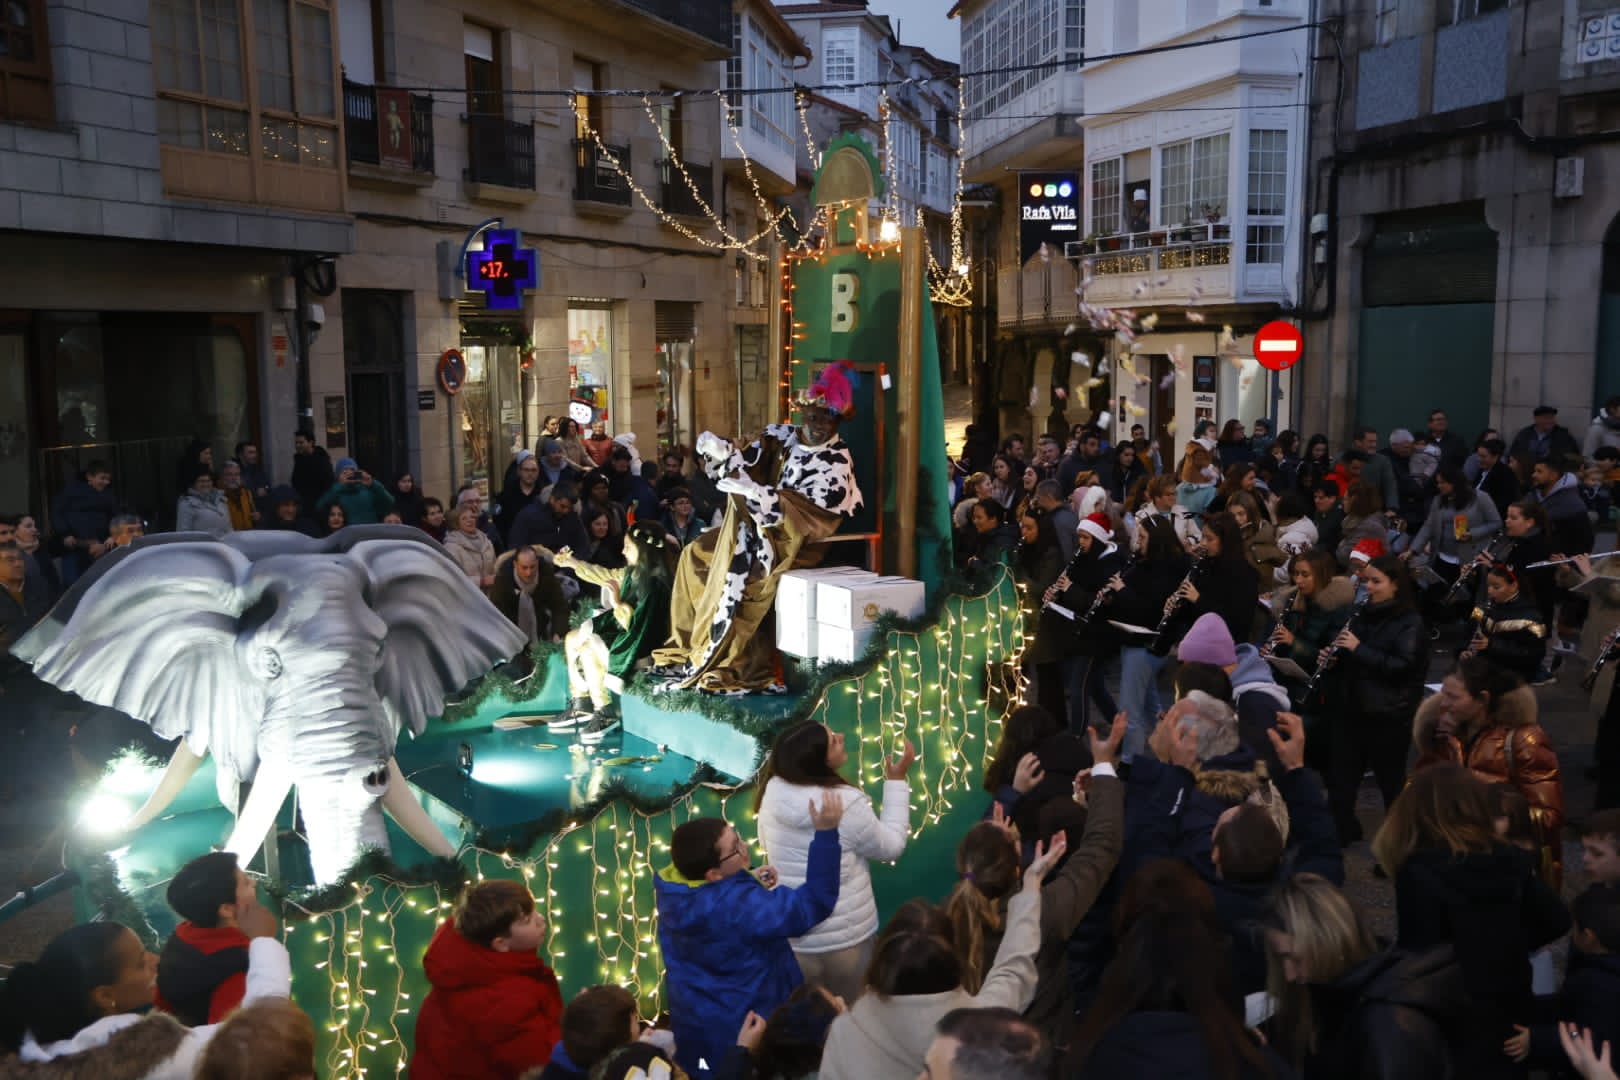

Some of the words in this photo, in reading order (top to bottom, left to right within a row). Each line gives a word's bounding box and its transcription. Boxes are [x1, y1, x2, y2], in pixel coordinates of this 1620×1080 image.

[1022, 205, 1051, 220] Rafa
[1052, 205, 1077, 220] Vila
[831, 273, 858, 333] B
